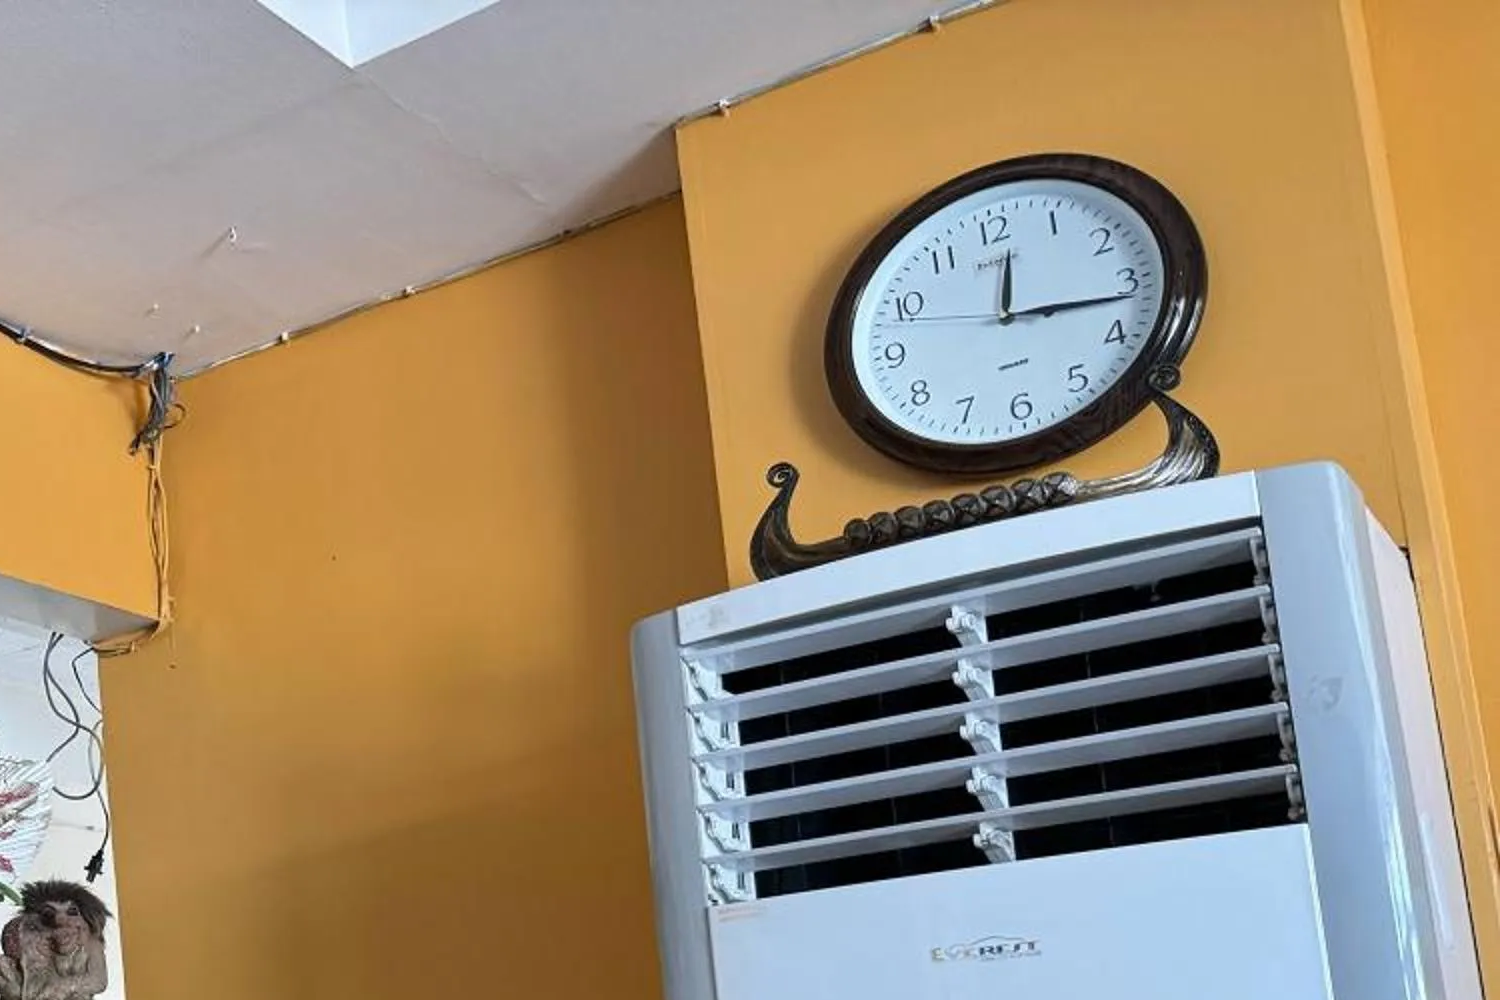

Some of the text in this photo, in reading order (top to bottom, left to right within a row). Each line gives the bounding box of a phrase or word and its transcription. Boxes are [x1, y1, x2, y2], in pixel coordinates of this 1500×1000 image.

[979, 215, 1011, 247] 12
[1048, 210, 1058, 235] 1
[1088, 226, 1115, 257] 2
[931, 244, 956, 275] 11
[1115, 267, 1140, 296] 3
[896, 291, 924, 322] 10
[1103, 318, 1127, 346] 4
[884, 342, 906, 370] 9
[910, 379, 932, 407] 8
[1066, 363, 1090, 394] 5
[954, 395, 976, 425] 7
[1009, 392, 1034, 421] 6
